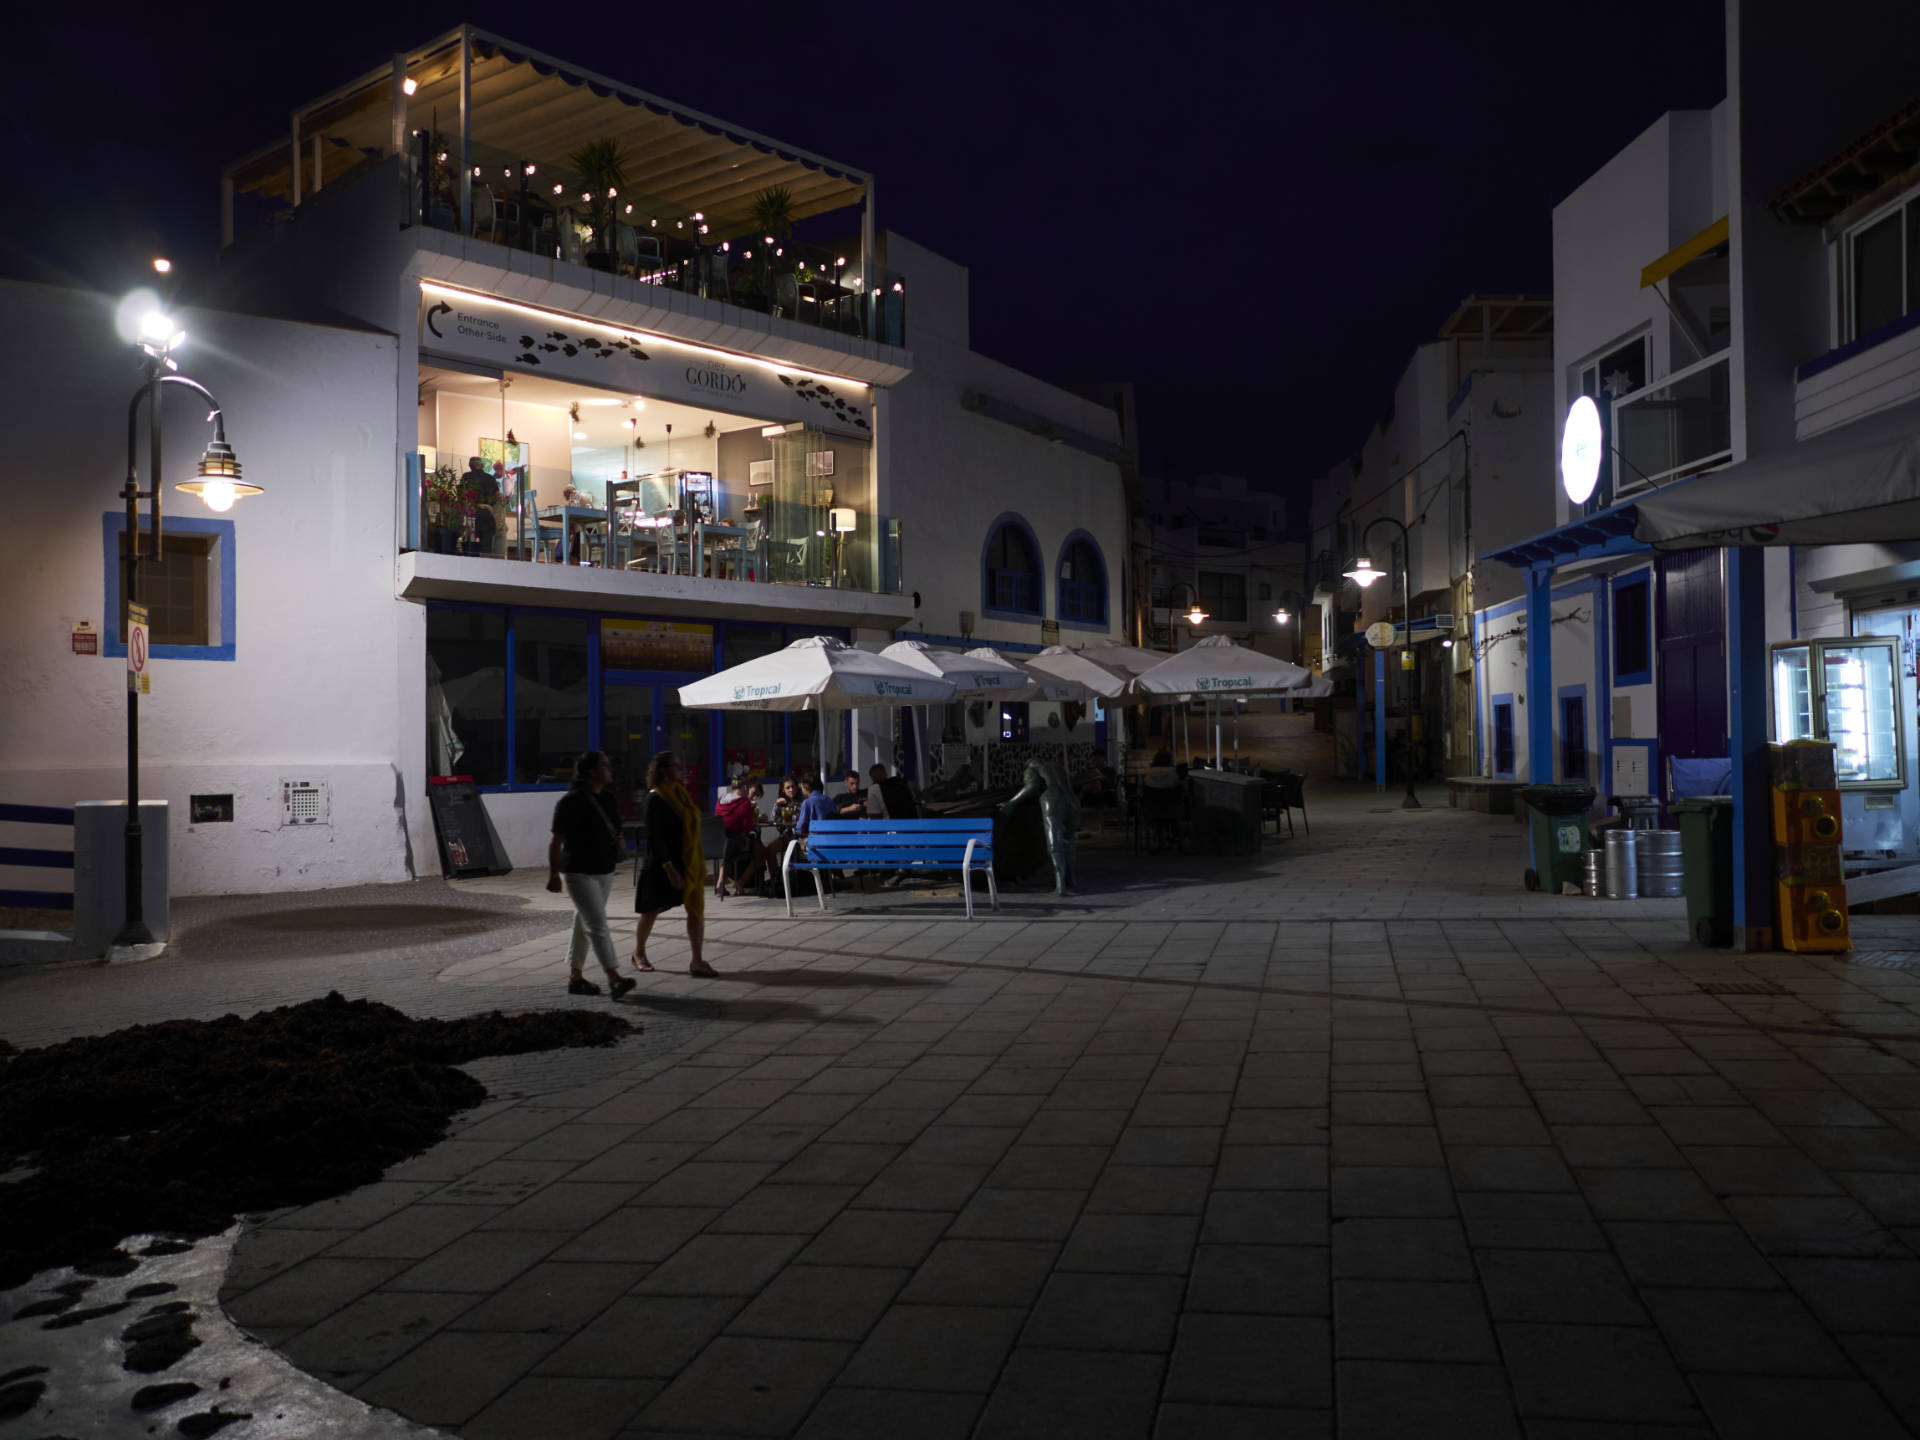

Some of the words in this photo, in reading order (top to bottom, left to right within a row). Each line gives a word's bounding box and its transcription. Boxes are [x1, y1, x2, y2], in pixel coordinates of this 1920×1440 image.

[457, 312, 500, 330] Entrance
[457, 325, 484, 338] Other
[486, 331, 507, 344] Side
[746, 682, 782, 697] Tropical
[884, 681, 913, 696] Tropical
[1211, 676, 1252, 688] Tropical
